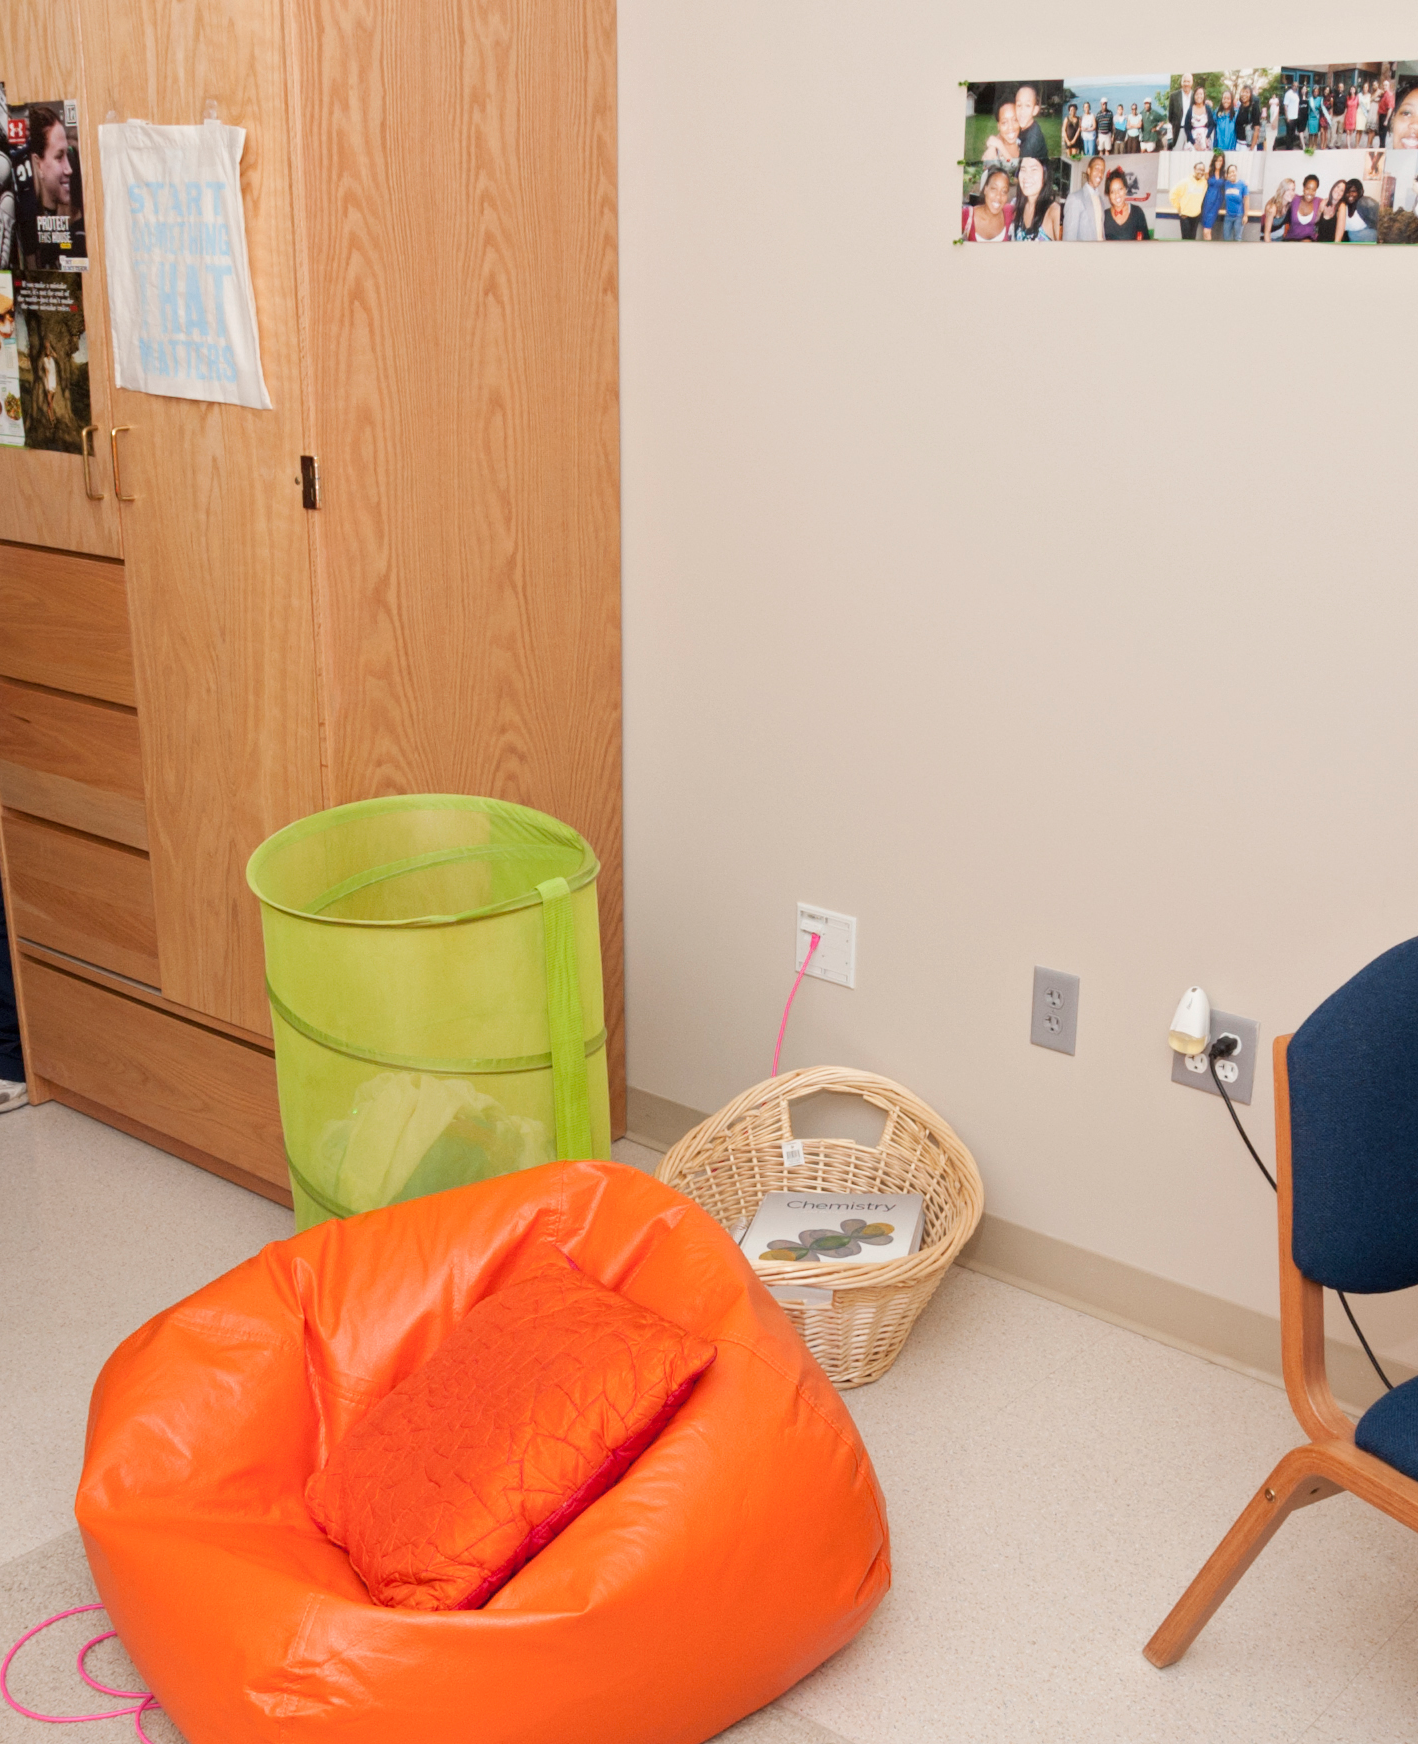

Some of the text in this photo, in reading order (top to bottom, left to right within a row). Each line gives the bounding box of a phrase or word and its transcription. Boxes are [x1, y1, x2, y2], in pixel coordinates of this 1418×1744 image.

[128, 181, 226, 216] START
[37, 215, 70, 231] PROTECT
[38, 232, 51, 243] THIS
[131, 221, 231, 256] SOMETHING
[134, 259, 232, 338] THAT
[139, 338, 237, 383] MATTERS
[787, 1201, 896, 1212] Chemistry
